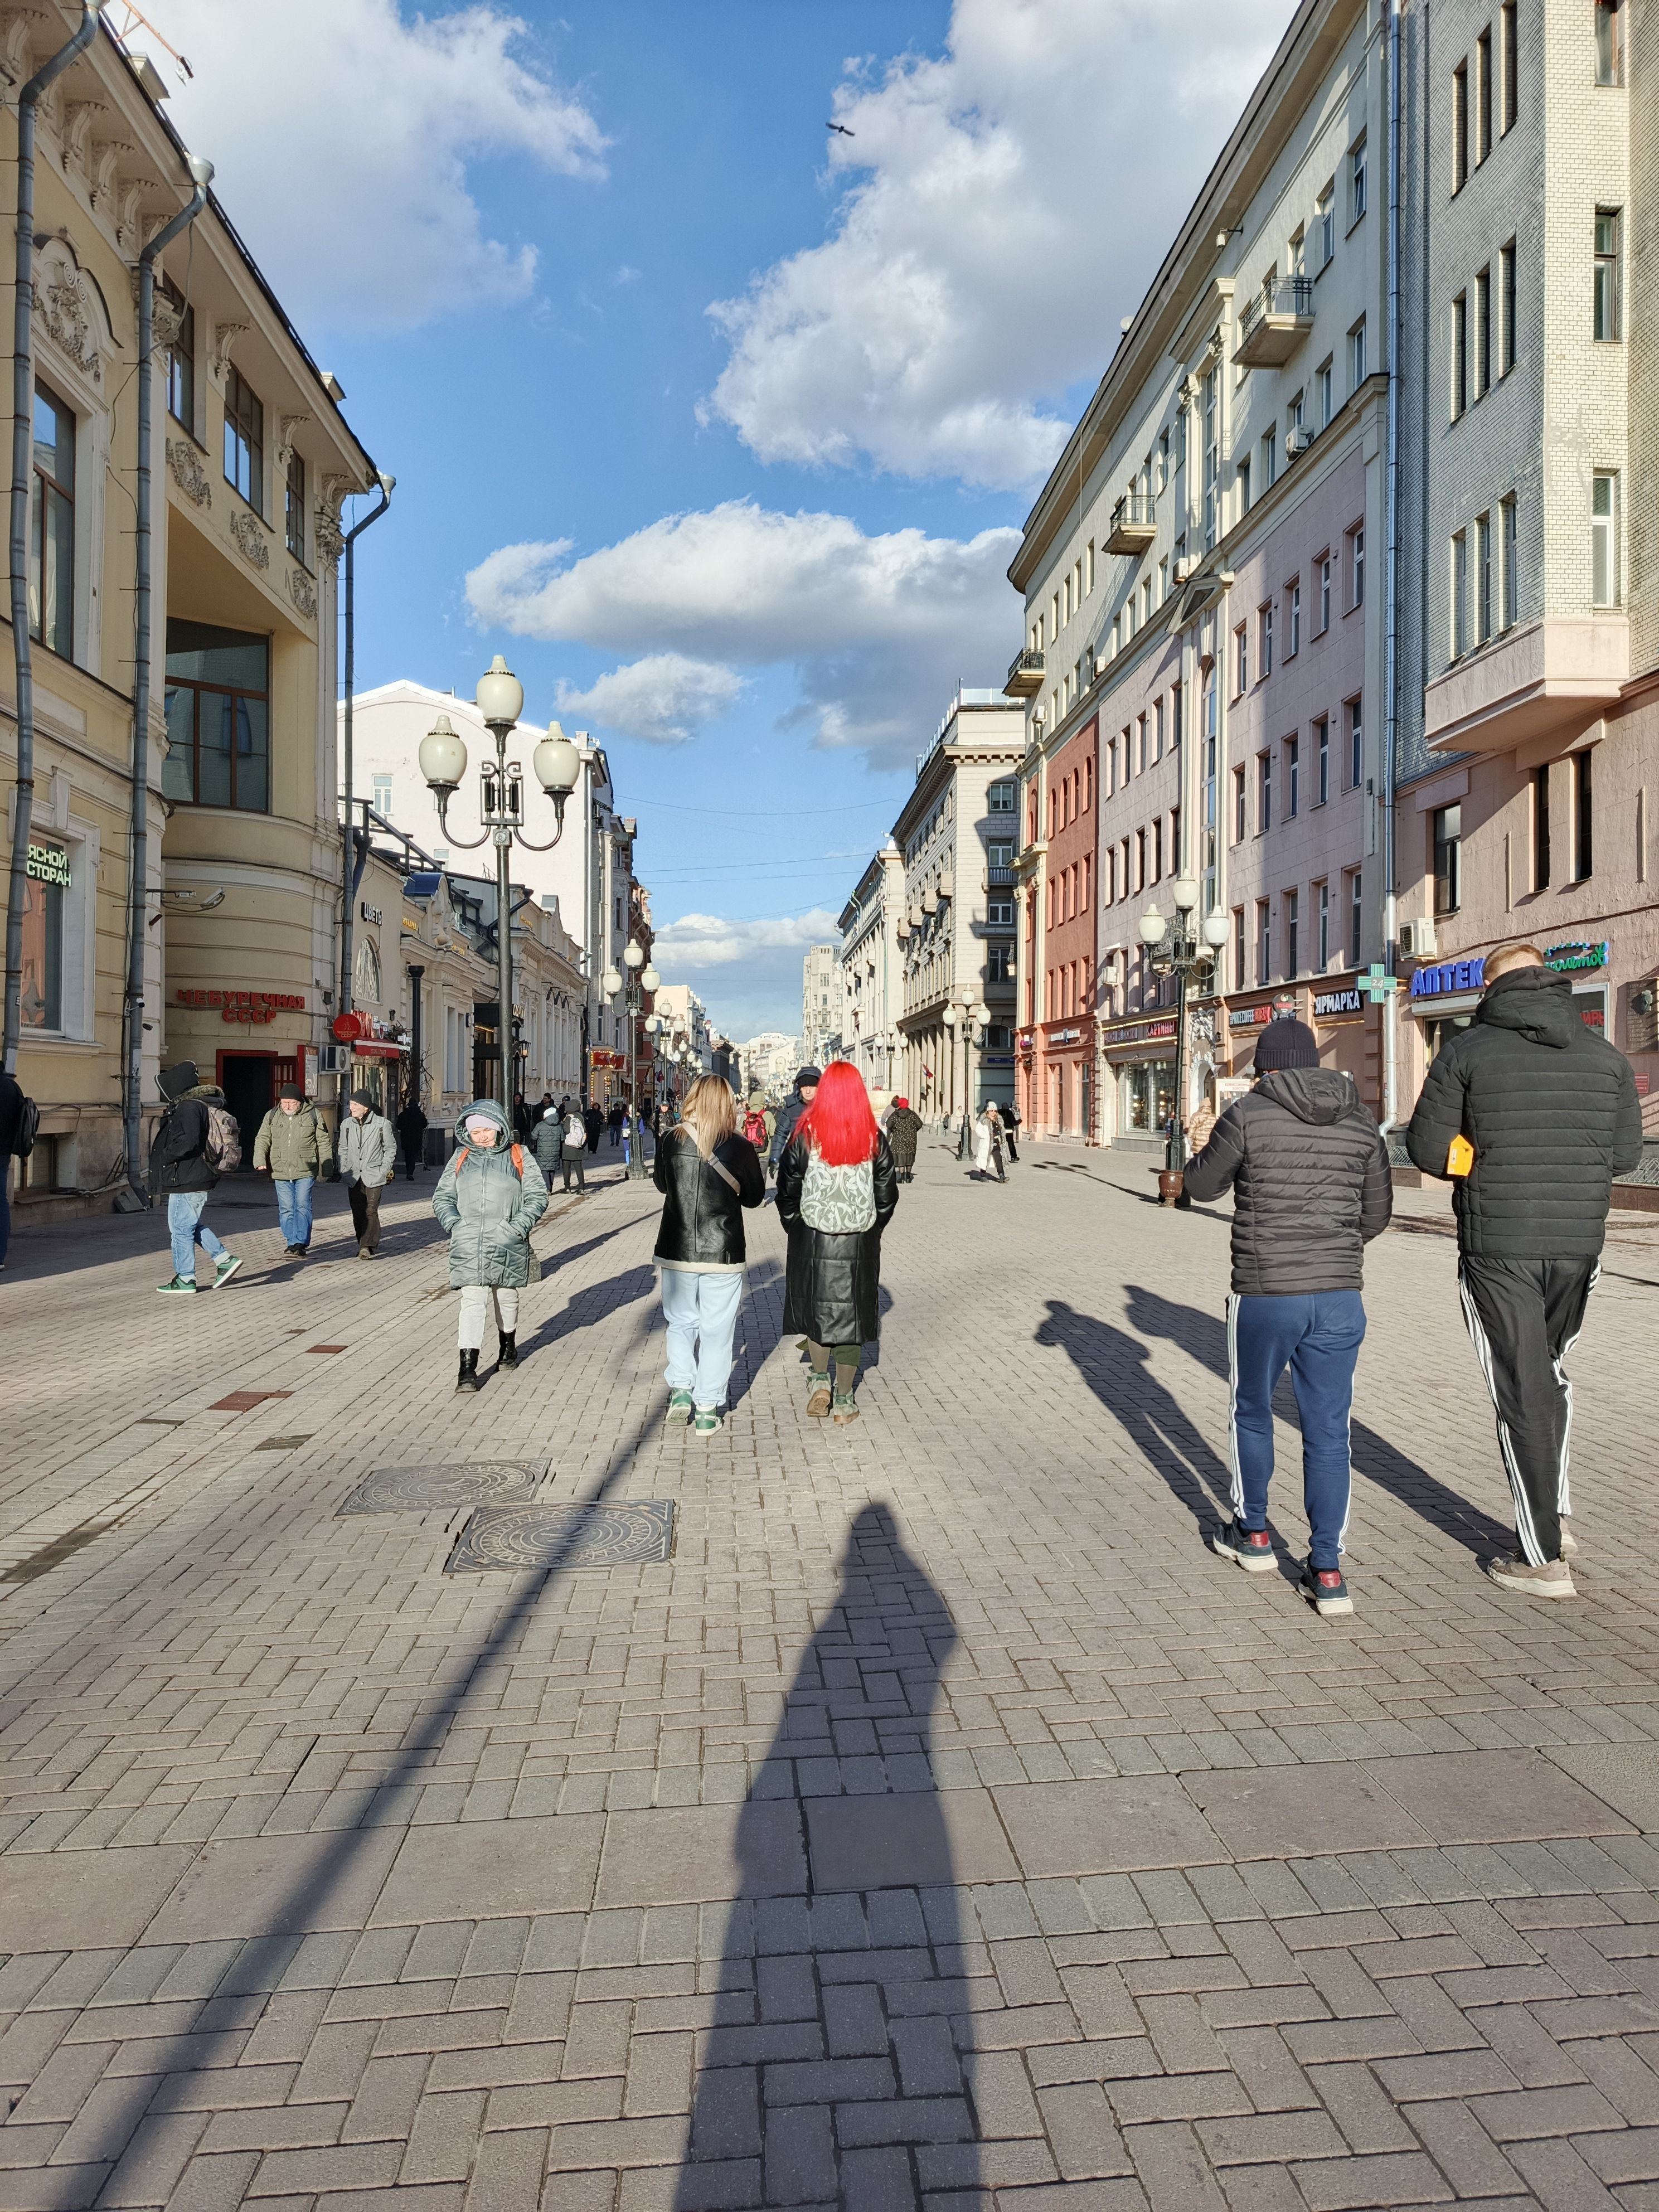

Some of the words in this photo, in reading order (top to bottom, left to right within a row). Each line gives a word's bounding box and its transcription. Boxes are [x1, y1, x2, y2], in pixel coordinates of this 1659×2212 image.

[28, 843, 67, 870] ЯСНОЙ
[27, 860, 71, 887] СТОРАН
[361, 901, 384, 926] ЦВЕТЫ
[1372, 979, 1384, 988] 24
[177, 989, 305, 1009] ЧЕБУРЕЧНАЯ
[1315, 991, 1360, 1015] ЯРМАРКА
[222, 1008, 277, 1023] СССР
[1146, 1020, 1175, 1036] КАРТИНЫ
